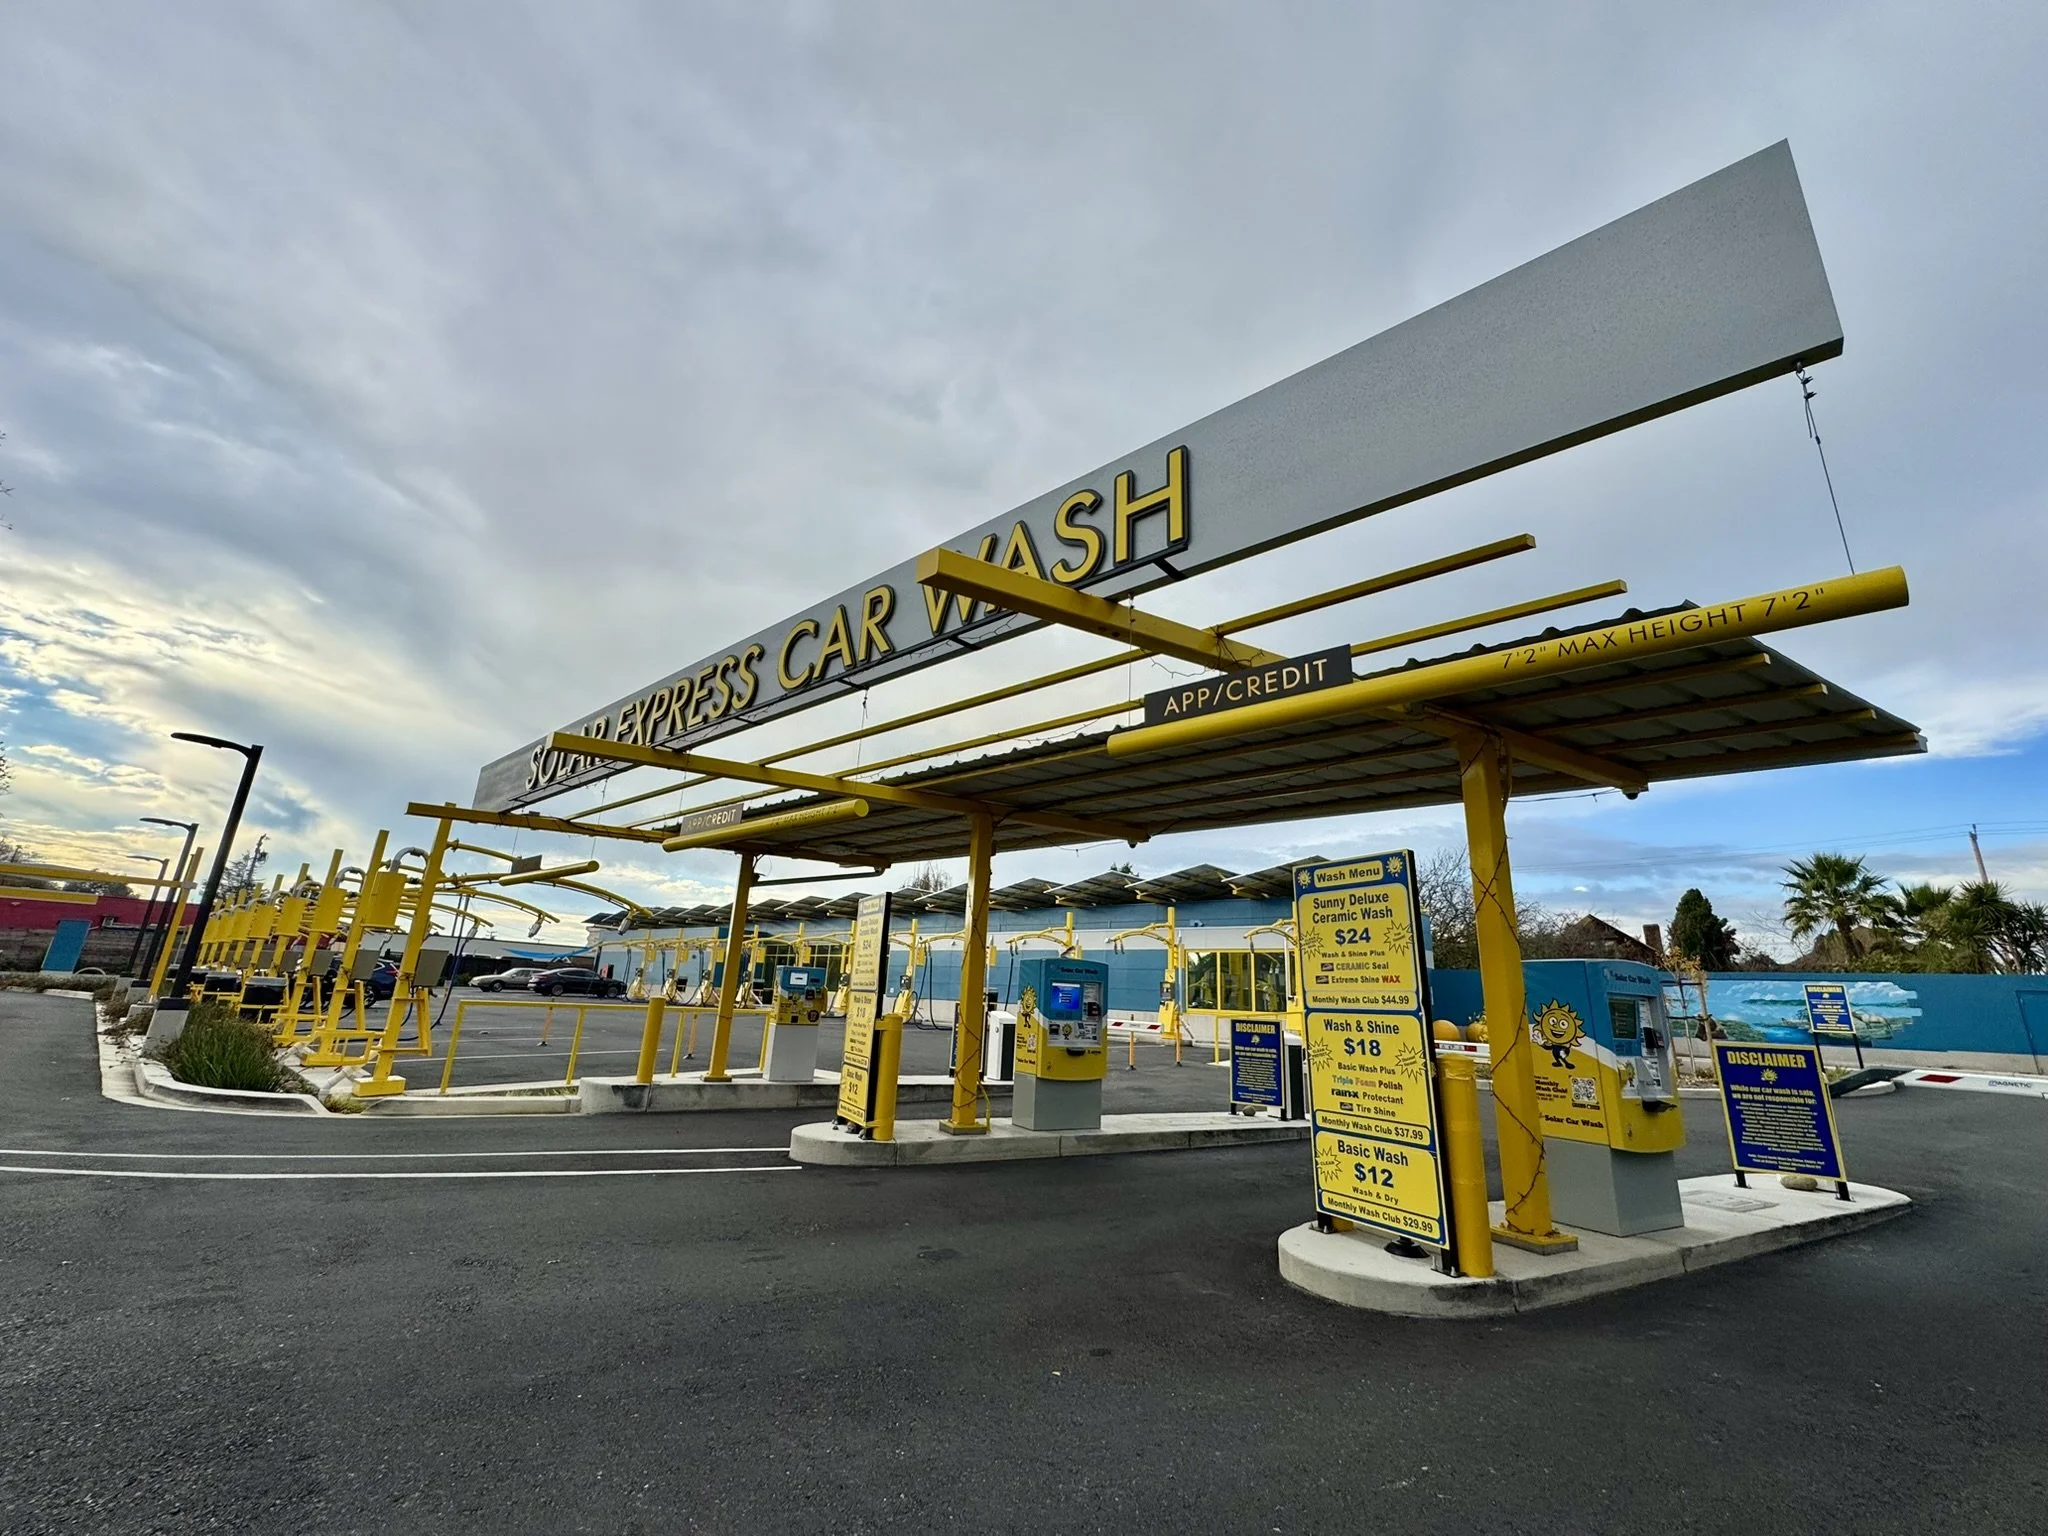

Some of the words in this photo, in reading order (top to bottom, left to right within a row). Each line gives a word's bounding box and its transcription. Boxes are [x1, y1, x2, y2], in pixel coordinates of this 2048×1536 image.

[614, 643, 764, 747] EXPRESS
[777, 583, 894, 691] CAR
[921, 445, 1188, 637] WASH
[1501, 646, 1546, 669] 7'2"
[1557, 632, 1618, 657] MAX
[1628, 603, 1747, 643] HEIGHT
[1761, 587, 1825, 617] 7'2"
[1163, 658, 1328, 717] APP/CREDIT
[1316, 870, 1346, 883] Wash
[1349, 867, 1380, 878] Menu
[1313, 897, 1346, 910] Sunny
[1349, 891, 1389, 906] Deluxe
[1312, 909, 1358, 924] Ceramic
[1360, 906, 1393, 920] Wash
[1335, 927, 1371, 947] $24
[1336, 962, 1370, 971] CERAMIC
[1371, 962, 1389, 970] Seal
[1360, 975, 1380, 983] Shine
[1381, 975, 1401, 983] WAX
[1312, 996, 1340, 1005] Monthly
[1340, 996, 1360, 1004] Wash
[1362, 996, 1380, 1004] Club
[1381, 995, 1409, 1004] $44.99
[1235, 1022, 1276, 1034] DISCLAIMER
[1323, 1019, 1352, 1032] Wash
[1355, 1020, 1364, 1033] &
[1367, 1020, 1400, 1034] Shine
[1343, 1037, 1381, 1057] $18
[1726, 1051, 1807, 1068] DISCLAIMER
[1337, 1062, 1357, 1071] Basic
[1358, 1064, 1378, 1073] Wash
[1379, 1066, 1396, 1075] Plus
[1332, 1075, 1353, 1085] Triple
[1355, 1078, 1376, 1087] Foam
[1378, 1080, 1403, 1091] Polish
[1730, 1084, 1749, 1092] While
[1362, 1092, 1404, 1104] Protectant
[1765, 1095, 1804, 1103] responsible
[1355, 1104, 1371, 1113] Tire
[1373, 1107, 1396, 1117] Shine
[1321, 1116, 1351, 1129] Monthly
[1351, 1121, 1373, 1132] Wash
[1374, 1125, 1393, 1135] Club
[1394, 1127, 1424, 1140] $37.99
[1544, 1115, 1564, 1123] Solar
[1565, 1117, 1579, 1125] Car
[1581, 1119, 1604, 1128] Wash
[1337, 1140, 1370, 1158] Basic
[1373, 1146, 1409, 1166] Wash
[1354, 1162, 1394, 1188] $12
[1352, 1186, 1373, 1197] Wash
[1384, 1194, 1399, 1205] Dry
[1327, 1197, 1357, 1214] Monthly
[1358, 1205, 1380, 1219] Wash
[1382, 1212, 1401, 1225] Club
[1402, 1216, 1433, 1233] $29.99
